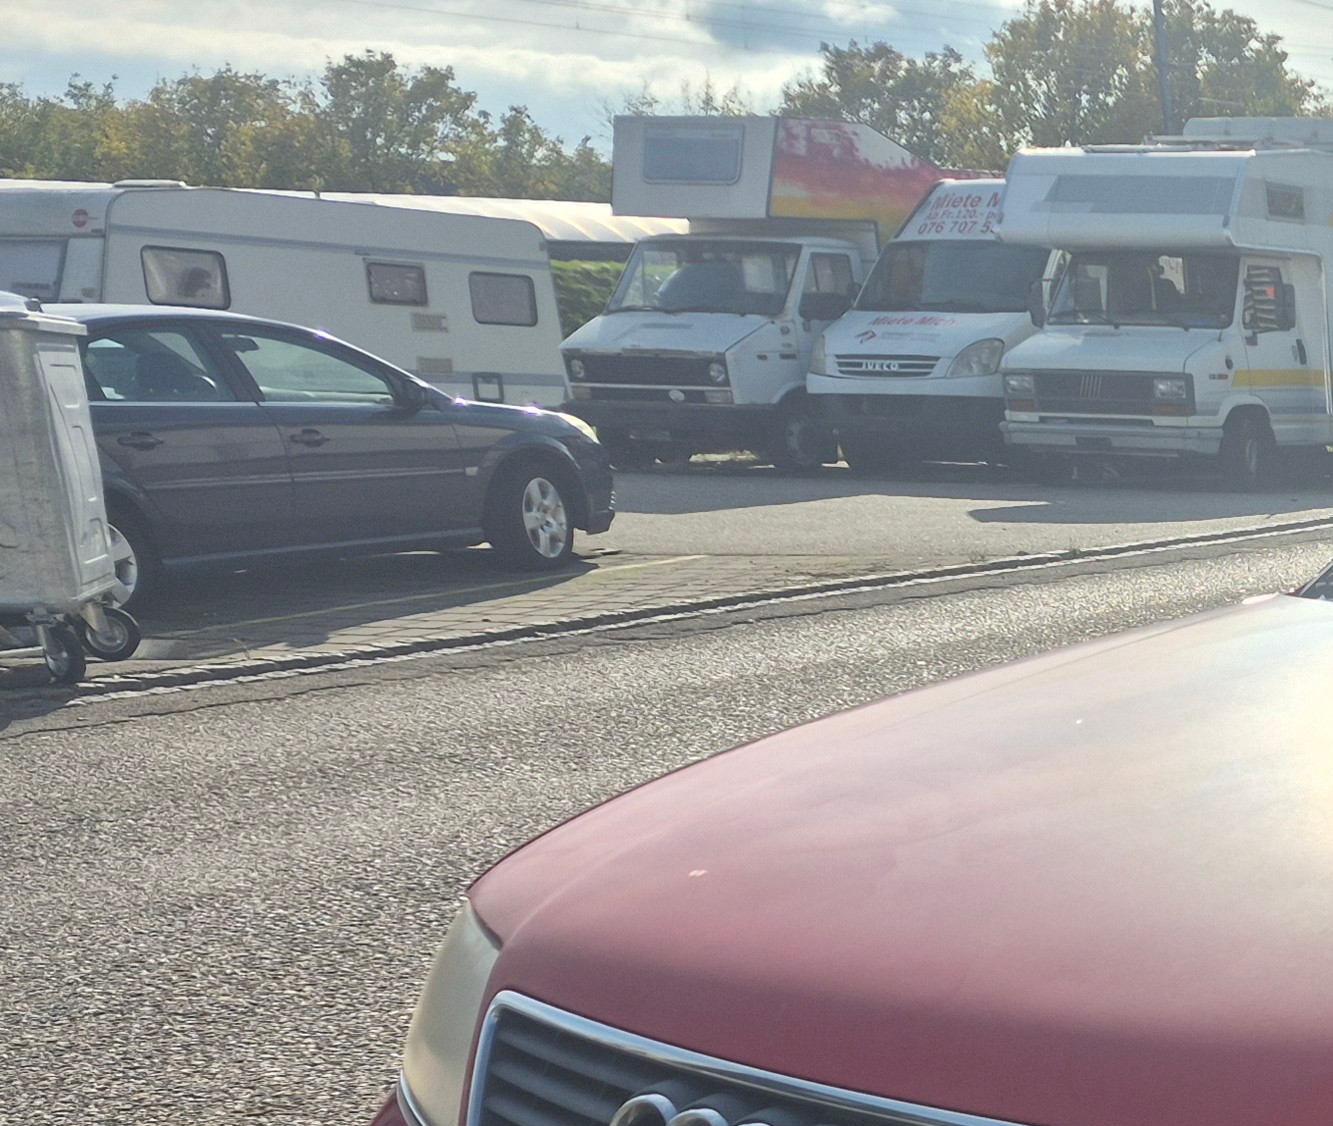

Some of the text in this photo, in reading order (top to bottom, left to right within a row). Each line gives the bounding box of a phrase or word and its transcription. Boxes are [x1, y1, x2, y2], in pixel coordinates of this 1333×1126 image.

[931, 192, 982, 210] Miete
[917, 221, 945, 235] 076
[949, 221, 979, 234] 707
[862, 361, 899, 371] IVECO
